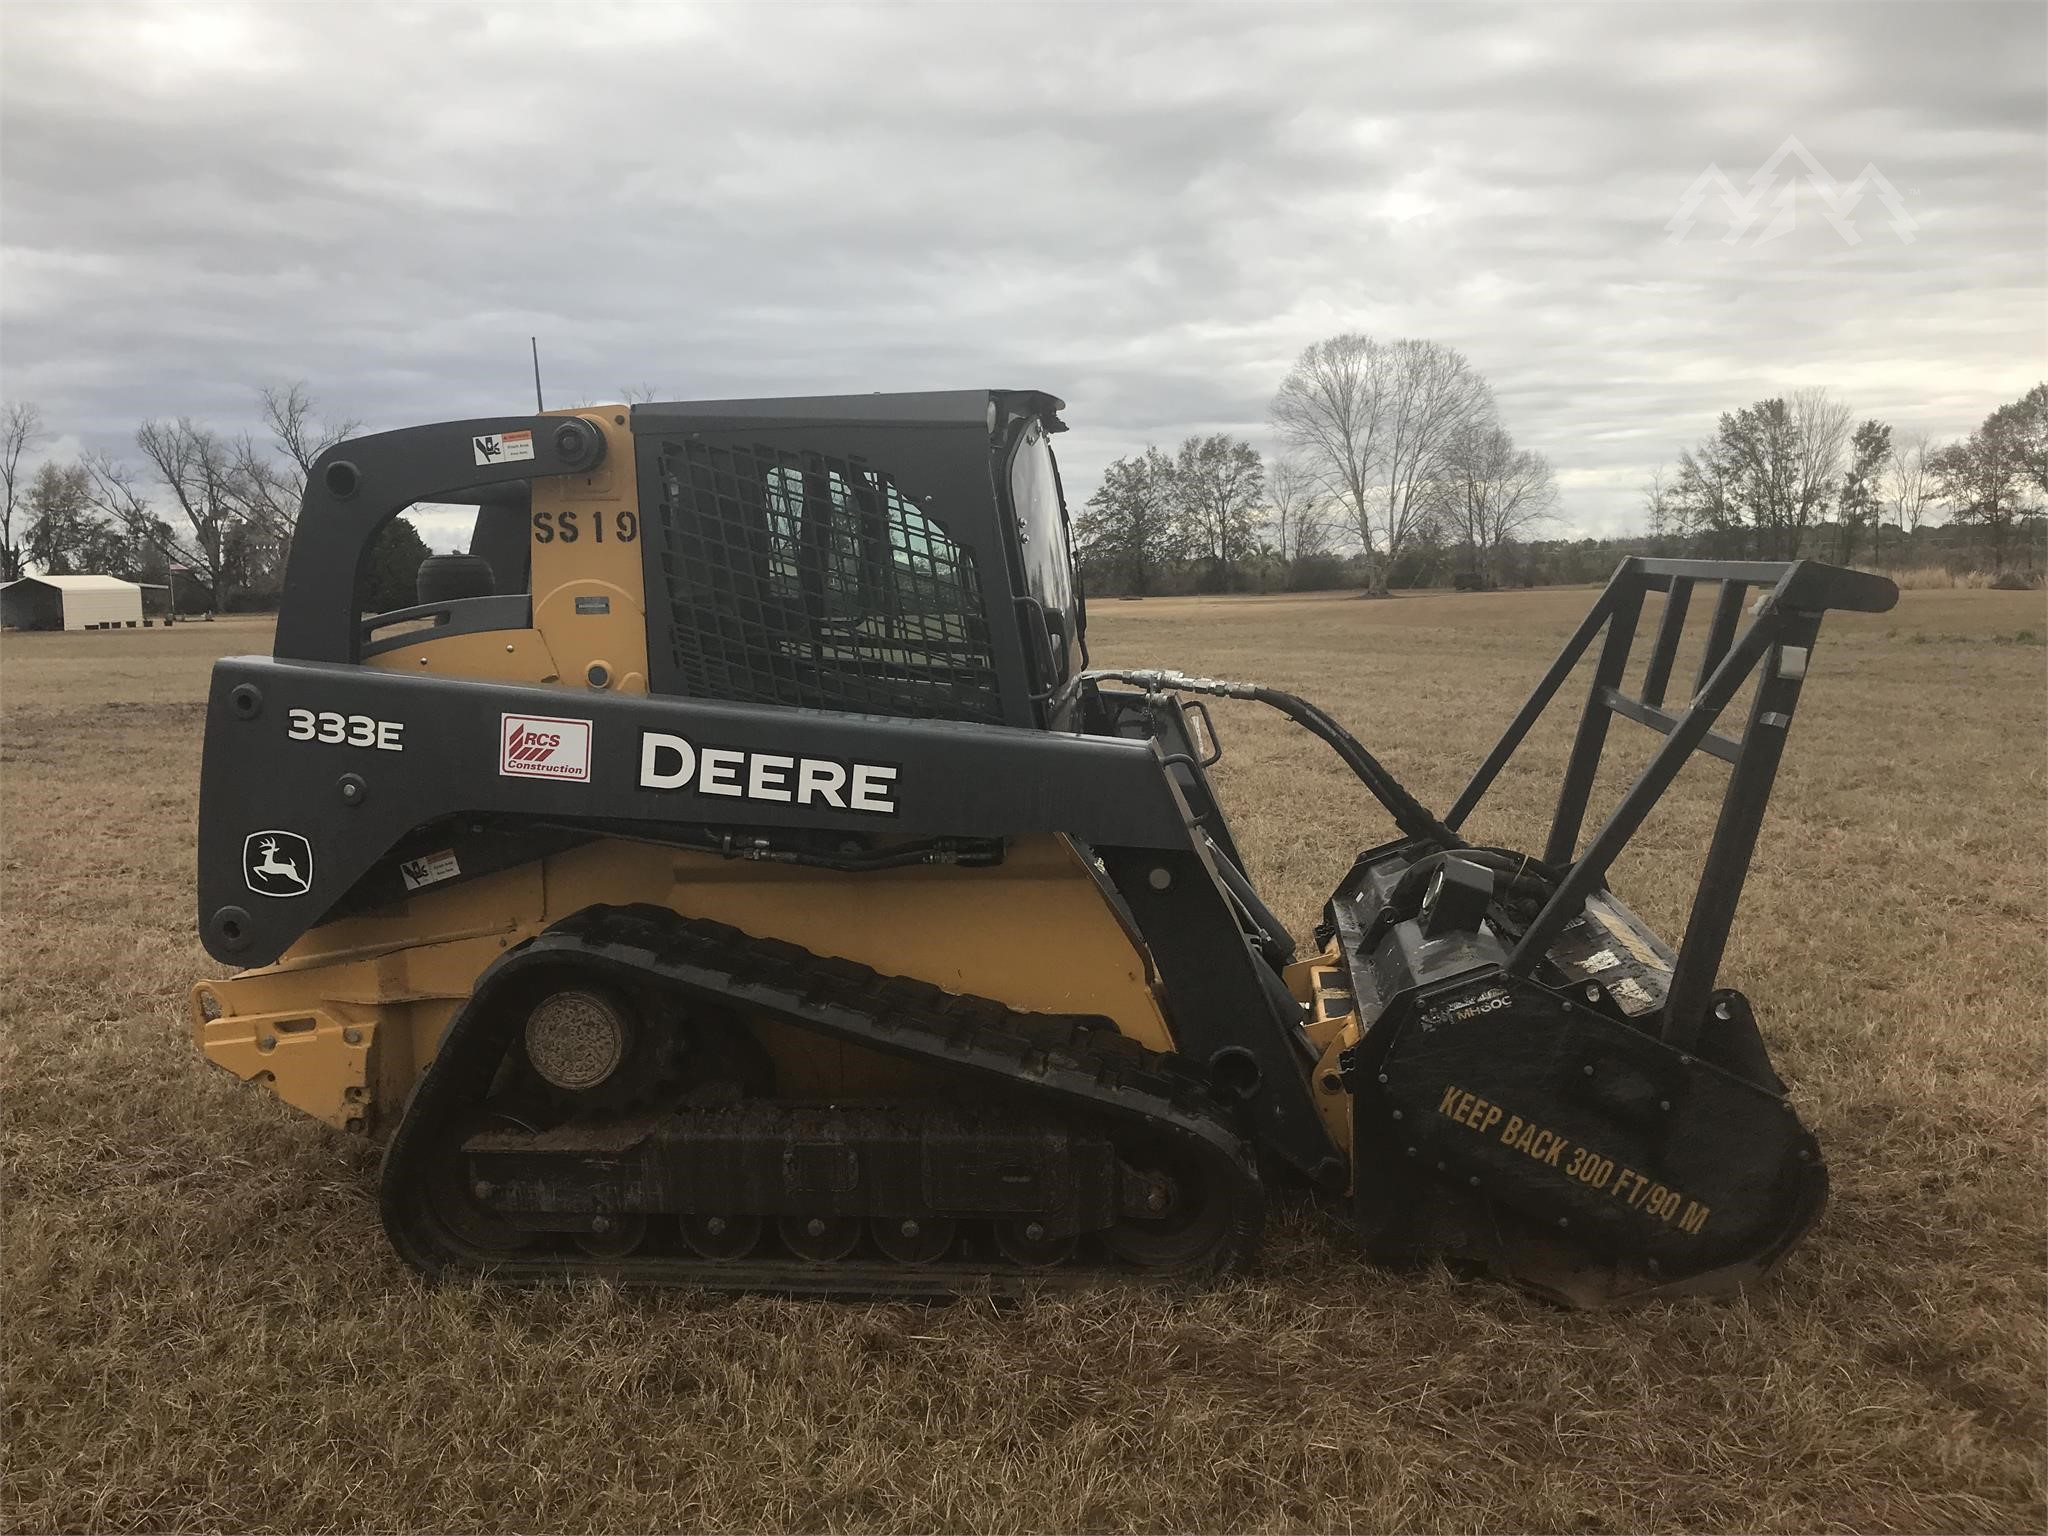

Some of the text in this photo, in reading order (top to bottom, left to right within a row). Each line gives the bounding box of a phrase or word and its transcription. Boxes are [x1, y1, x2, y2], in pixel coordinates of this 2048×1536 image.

[288, 708, 404, 751] 333E
[524, 732, 560, 747] RCS
[508, 760, 582, 774] Construction
[640, 731, 897, 813] DEERE
[1438, 1085, 1711, 1235] KEEP BACK 300 FT/90 M
